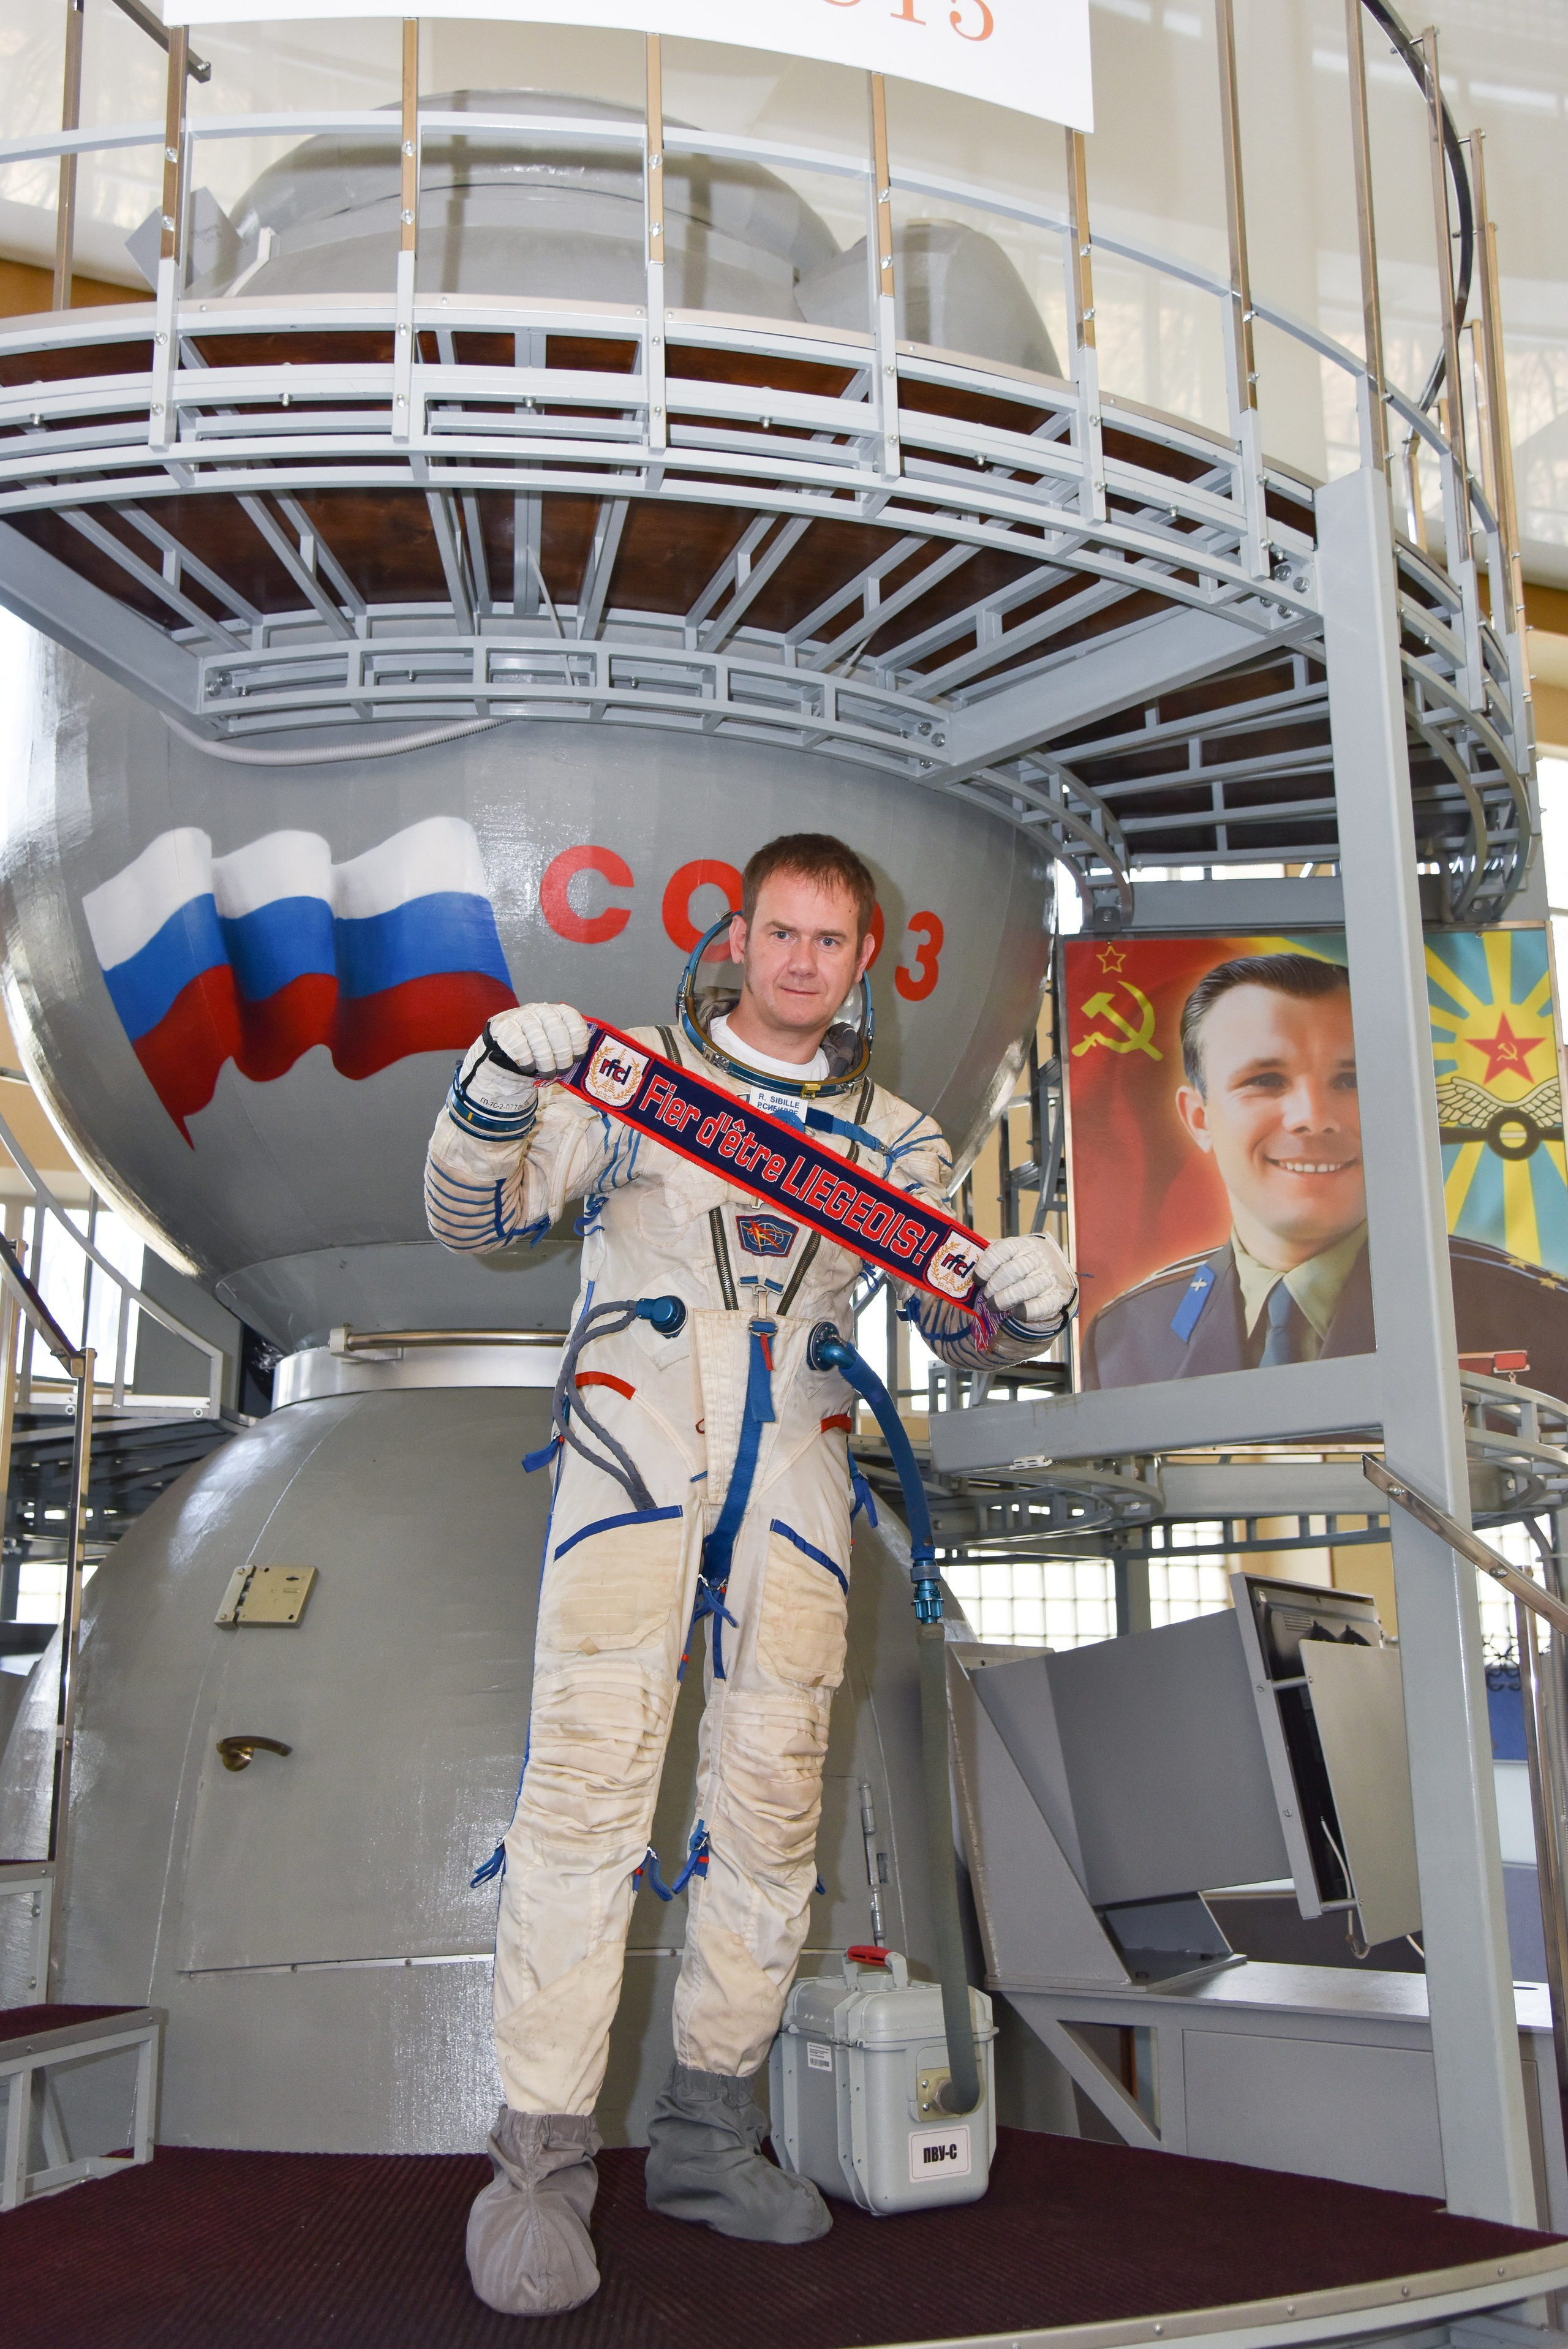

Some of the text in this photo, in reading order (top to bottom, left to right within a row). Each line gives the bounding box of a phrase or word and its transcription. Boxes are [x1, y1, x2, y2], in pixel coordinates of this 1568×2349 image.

[540, 845, 944, 1001] СОЗ
[770, 1096, 800, 1109] SIBILLE
[639, 1074, 938, 1265] Fier d'être LIEGEOIS!
[923, 2143, 957, 2163] ПВУ-С
